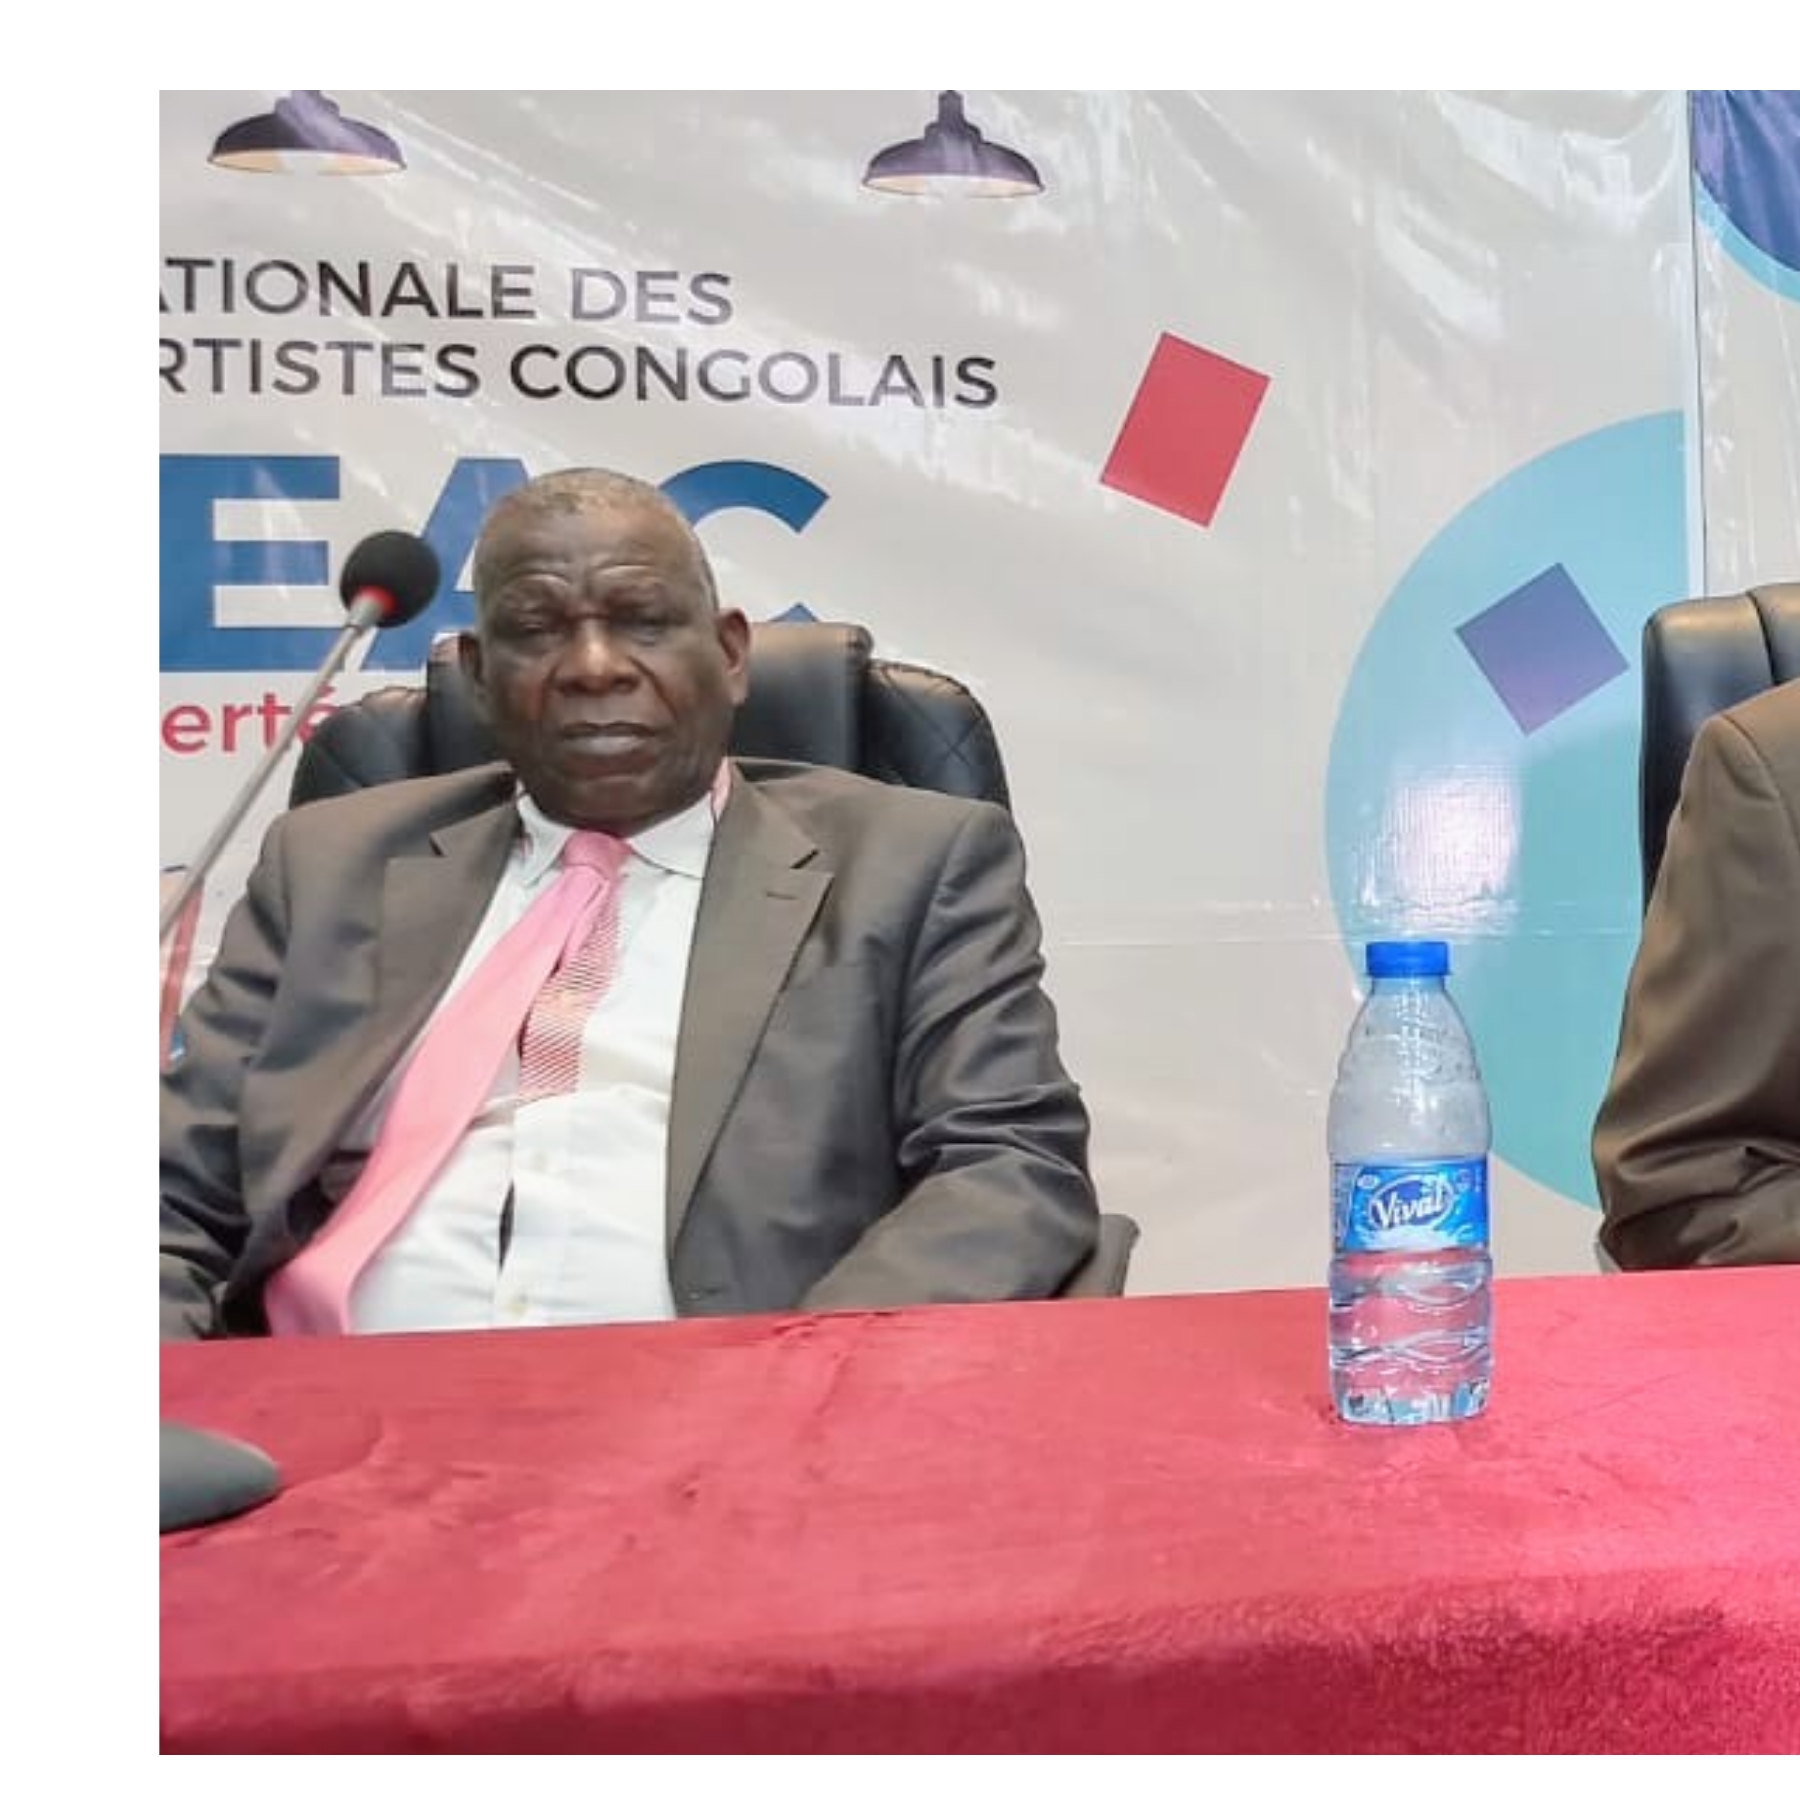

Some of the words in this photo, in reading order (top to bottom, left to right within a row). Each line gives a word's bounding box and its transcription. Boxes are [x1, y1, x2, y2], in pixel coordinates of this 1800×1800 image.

[160, 258, 536, 319] TIONALE
[571, 267, 734, 325] DES
[509, 344, 999, 409] CONGOLAIS
